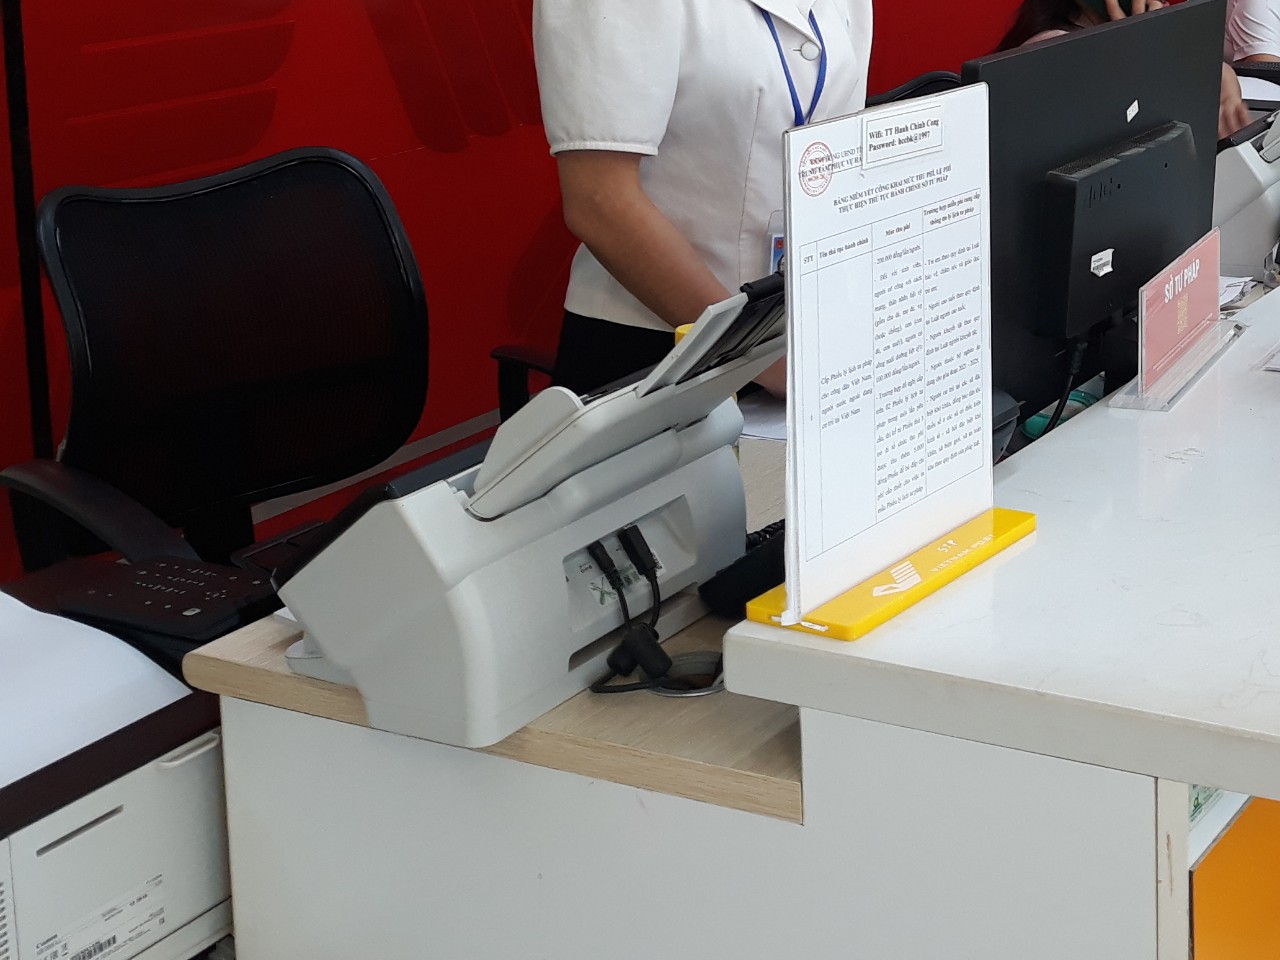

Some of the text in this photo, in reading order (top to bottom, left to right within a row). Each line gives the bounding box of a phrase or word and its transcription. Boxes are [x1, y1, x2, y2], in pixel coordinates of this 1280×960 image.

[885, 128, 893, 136] TT
[869, 139, 897, 151] Password:
[1164, 257, 1200, 304] SỞ TƯ PHÁP
